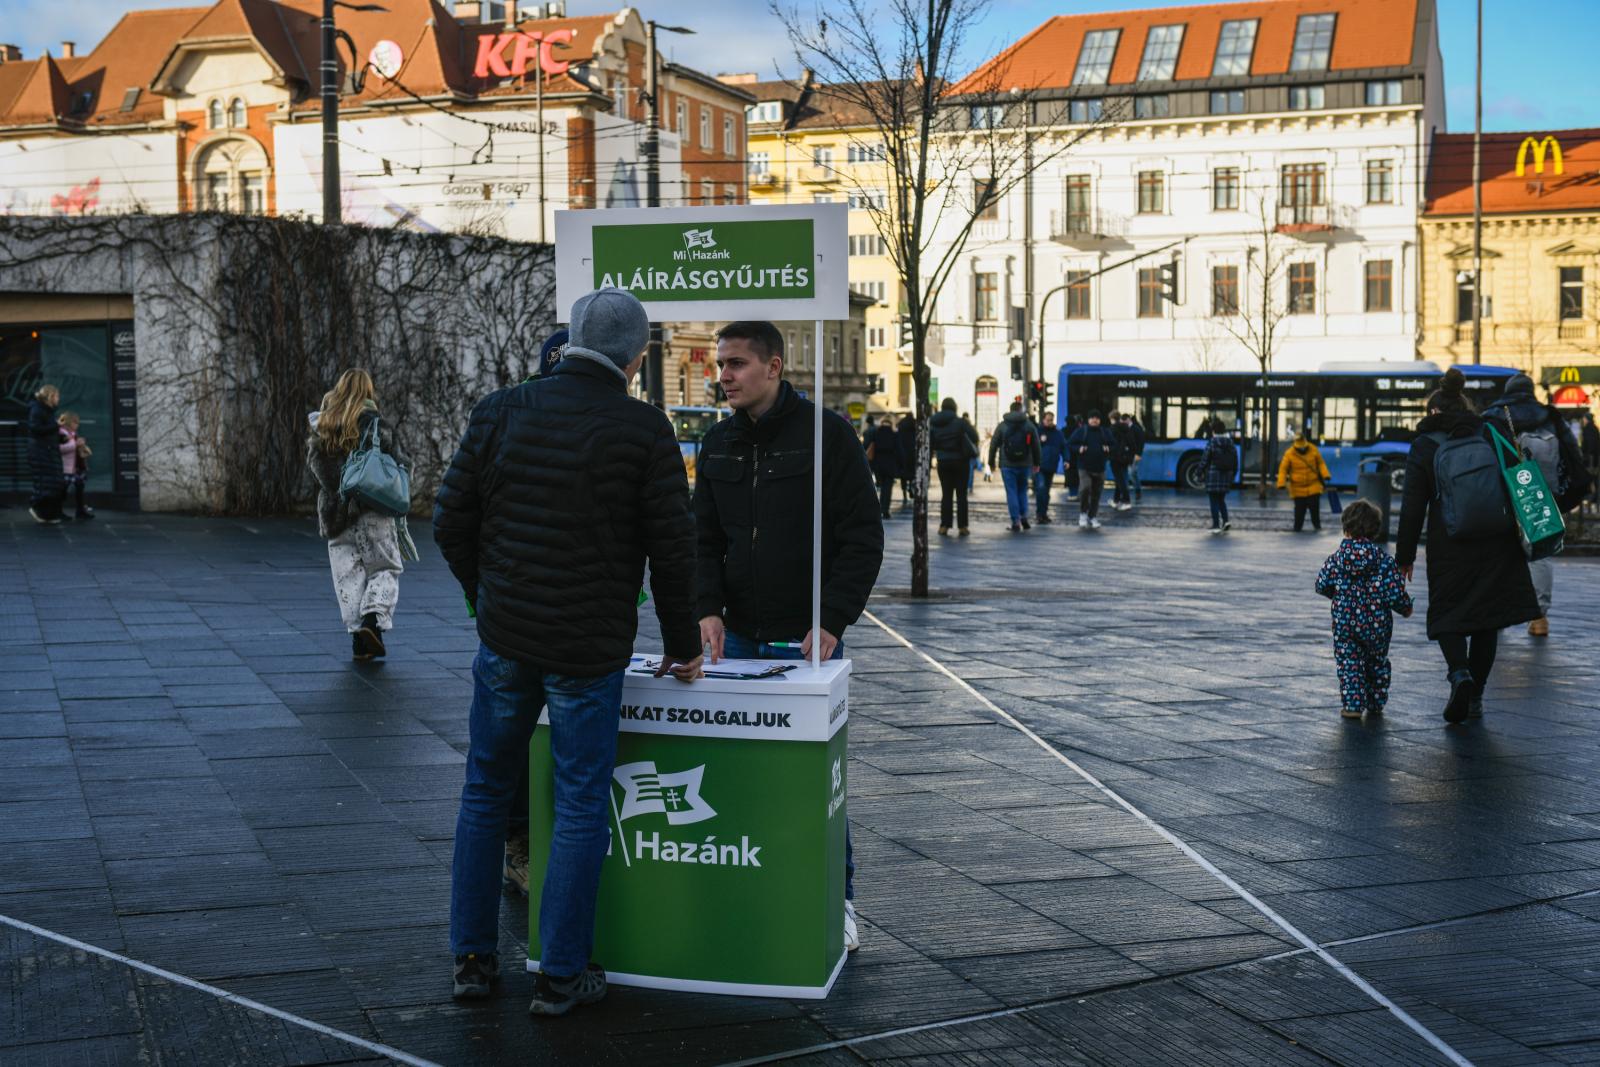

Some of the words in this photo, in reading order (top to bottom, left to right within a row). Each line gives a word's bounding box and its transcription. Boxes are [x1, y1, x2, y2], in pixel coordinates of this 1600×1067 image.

[474, 29, 572, 77] KFC
[442, 184, 485, 196] Galaxy
[673, 251, 686, 260] Mi
[692, 249, 730, 260] Hazánk
[601, 264, 809, 291] ALÁÍRÁSGYŰJTÉS
[620, 704, 664, 721] NKAT
[667, 708, 791, 728] SZOLGÁLJUK
[635, 830, 762, 867] Hazánk
